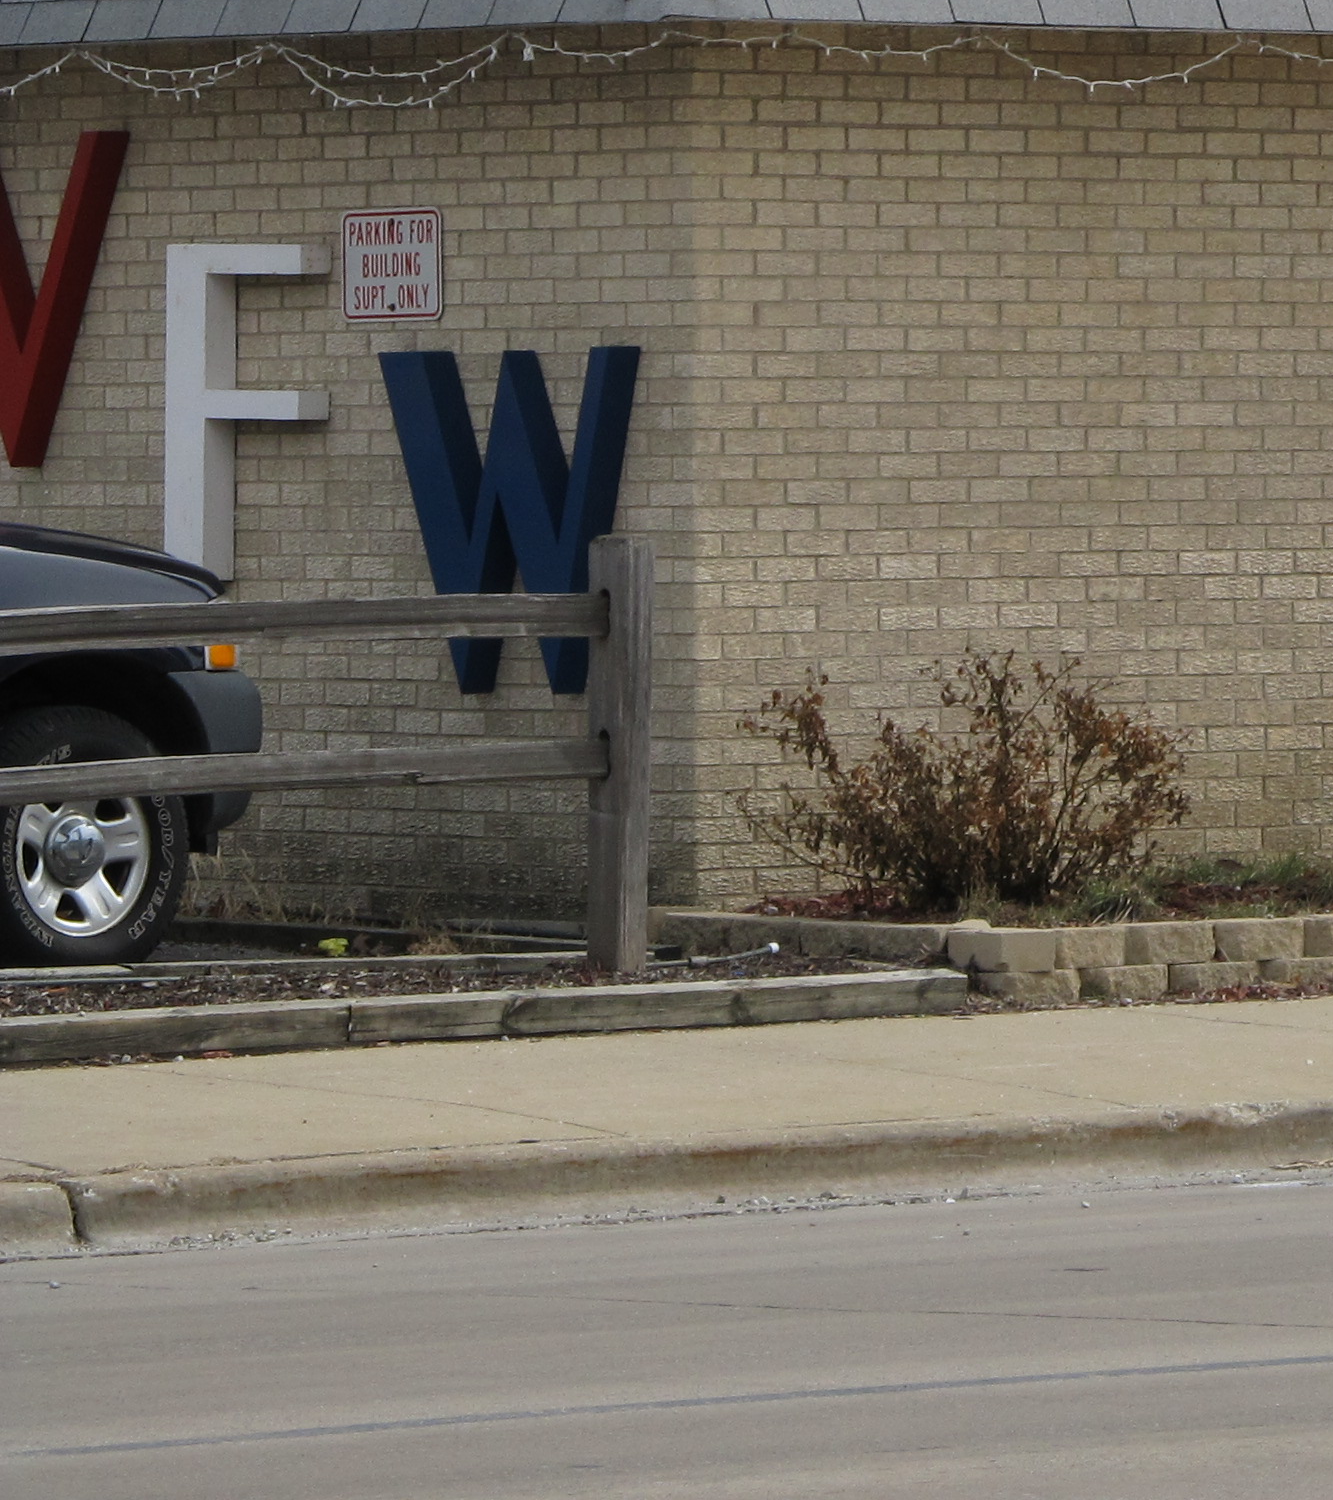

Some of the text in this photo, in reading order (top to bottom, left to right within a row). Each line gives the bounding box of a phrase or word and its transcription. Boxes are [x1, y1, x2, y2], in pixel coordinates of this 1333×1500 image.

[349, 219, 433, 246] PARKING FOR
[362, 252, 421, 278] BUILDING
[398, 284, 430, 308] ONLY
[128, 796, 174, 940] OODYEAR
